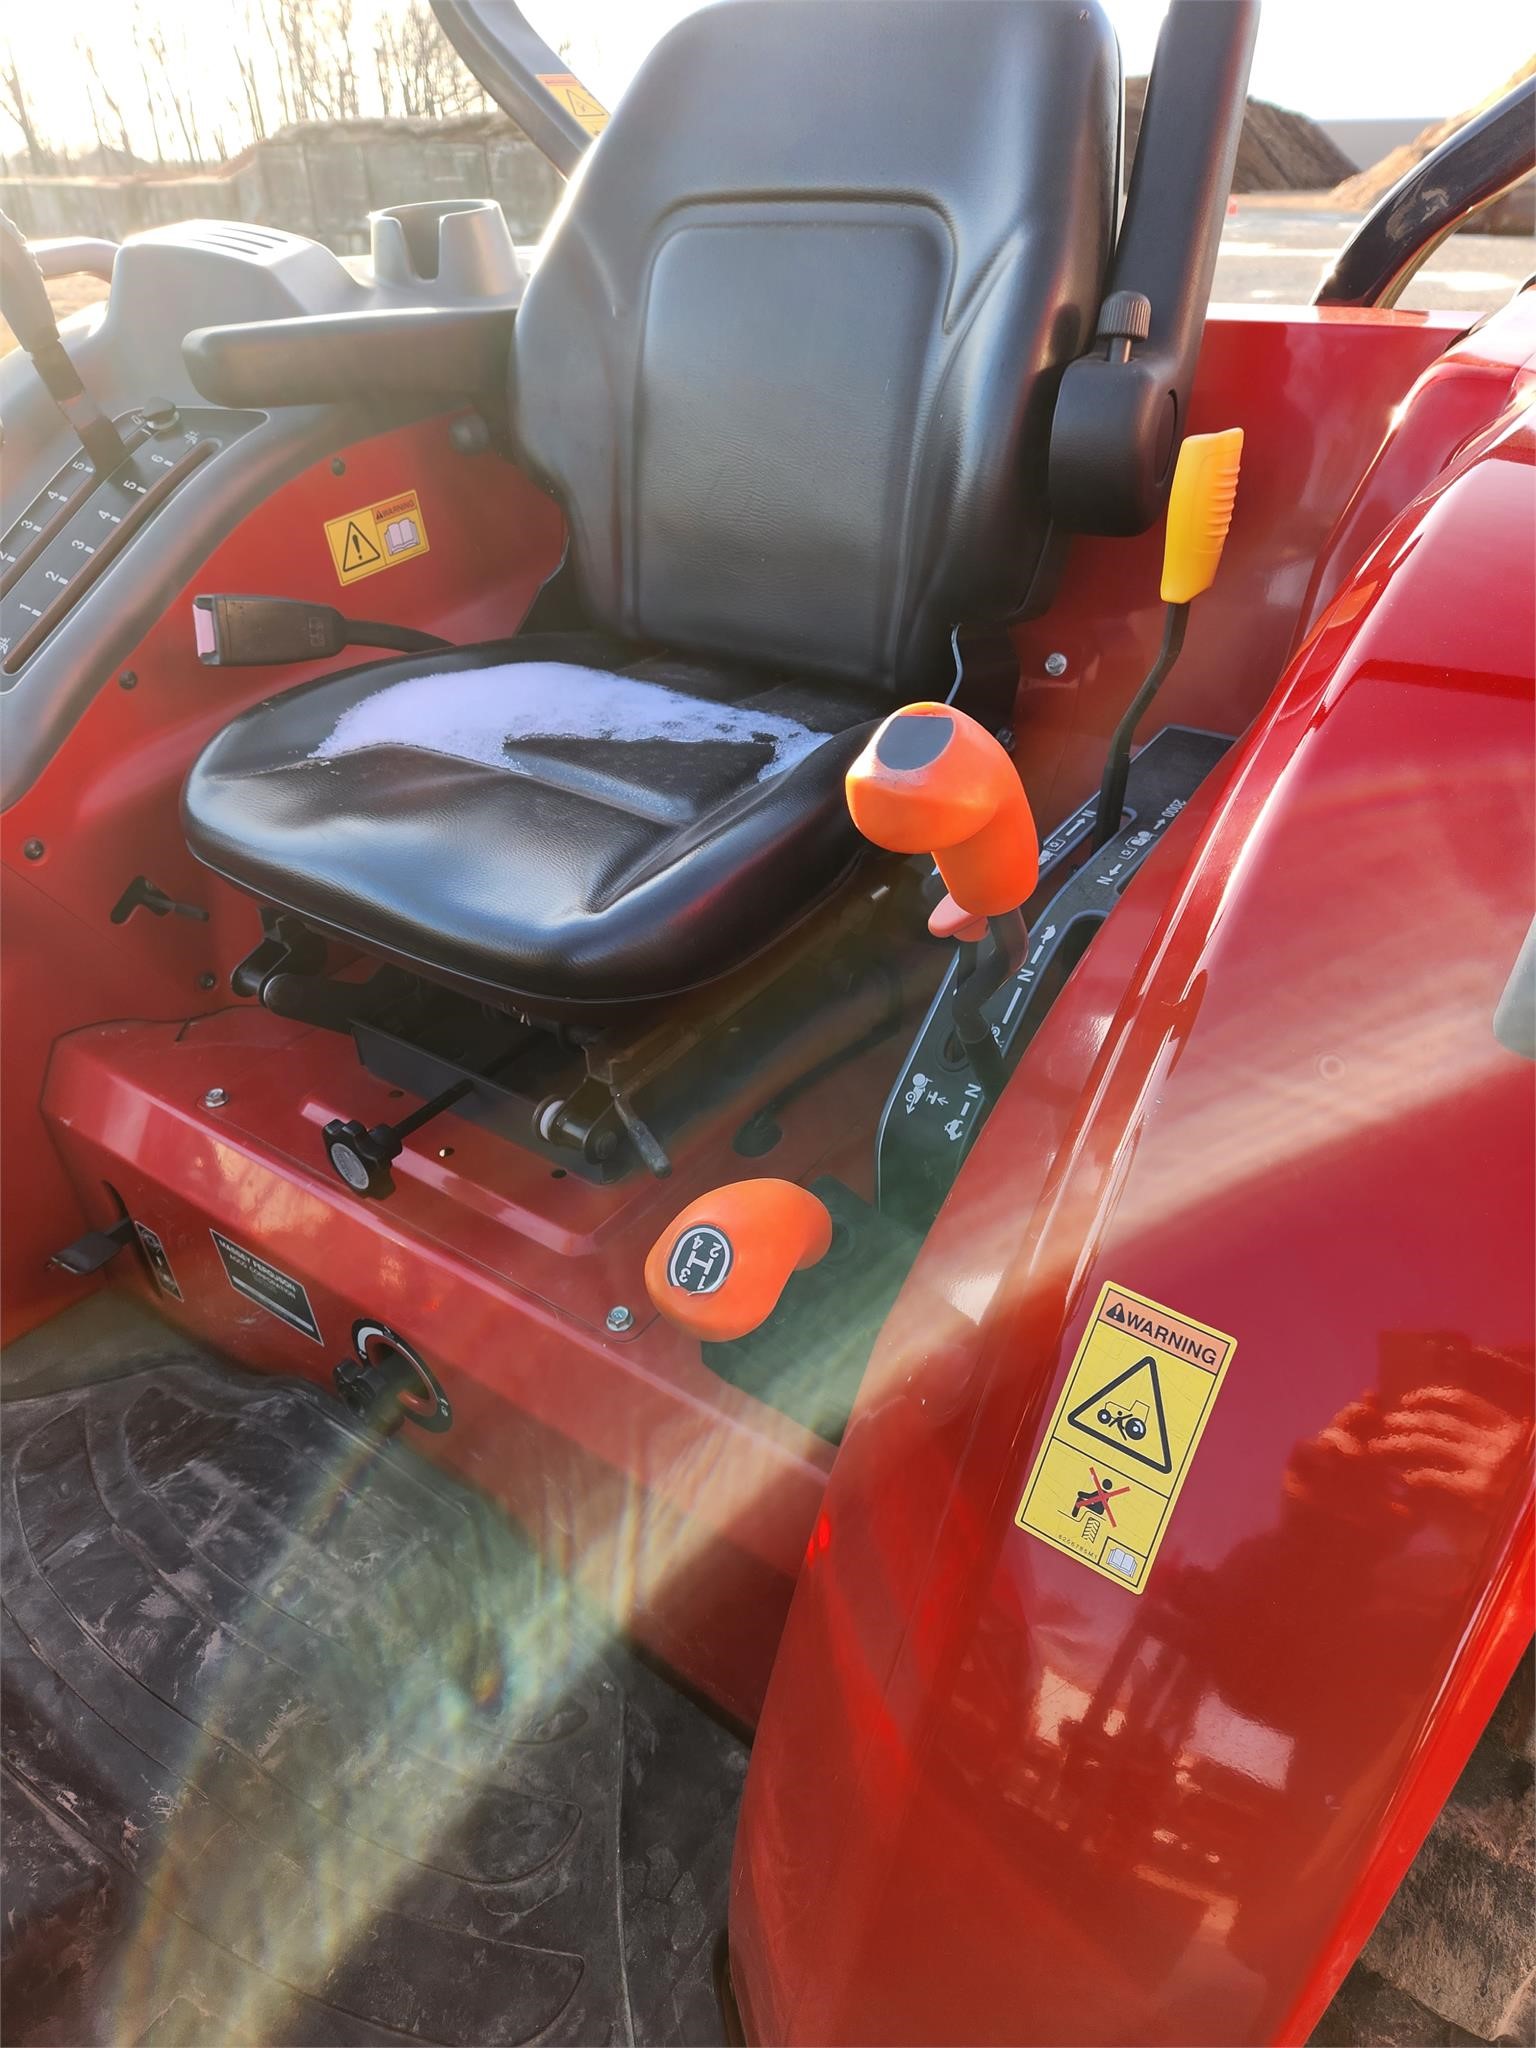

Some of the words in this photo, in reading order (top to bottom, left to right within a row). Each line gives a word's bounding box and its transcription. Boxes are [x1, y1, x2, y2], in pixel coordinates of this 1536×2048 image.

[151, 453, 164, 463] 6
[72, 460, 85, 470] 5
[123, 480, 137, 490] 5
[47, 490, 59, 500] 4
[98, 509, 111, 520] 4
[21, 520, 33, 529] 3
[71, 539, 85, 549] 3
[45, 570, 59, 582] 2
[19, 603, 32, 612] 1
[1017, 968, 1035, 983] N
[964, 1083, 982, 1099] N
[692, 1235, 704, 1250] 4
[709, 1242, 723, 1258] 2
[678, 1267, 691, 1284] 3
[697, 1275, 706, 1290] 1
[1127, 1310, 1218, 1366] WARNING
